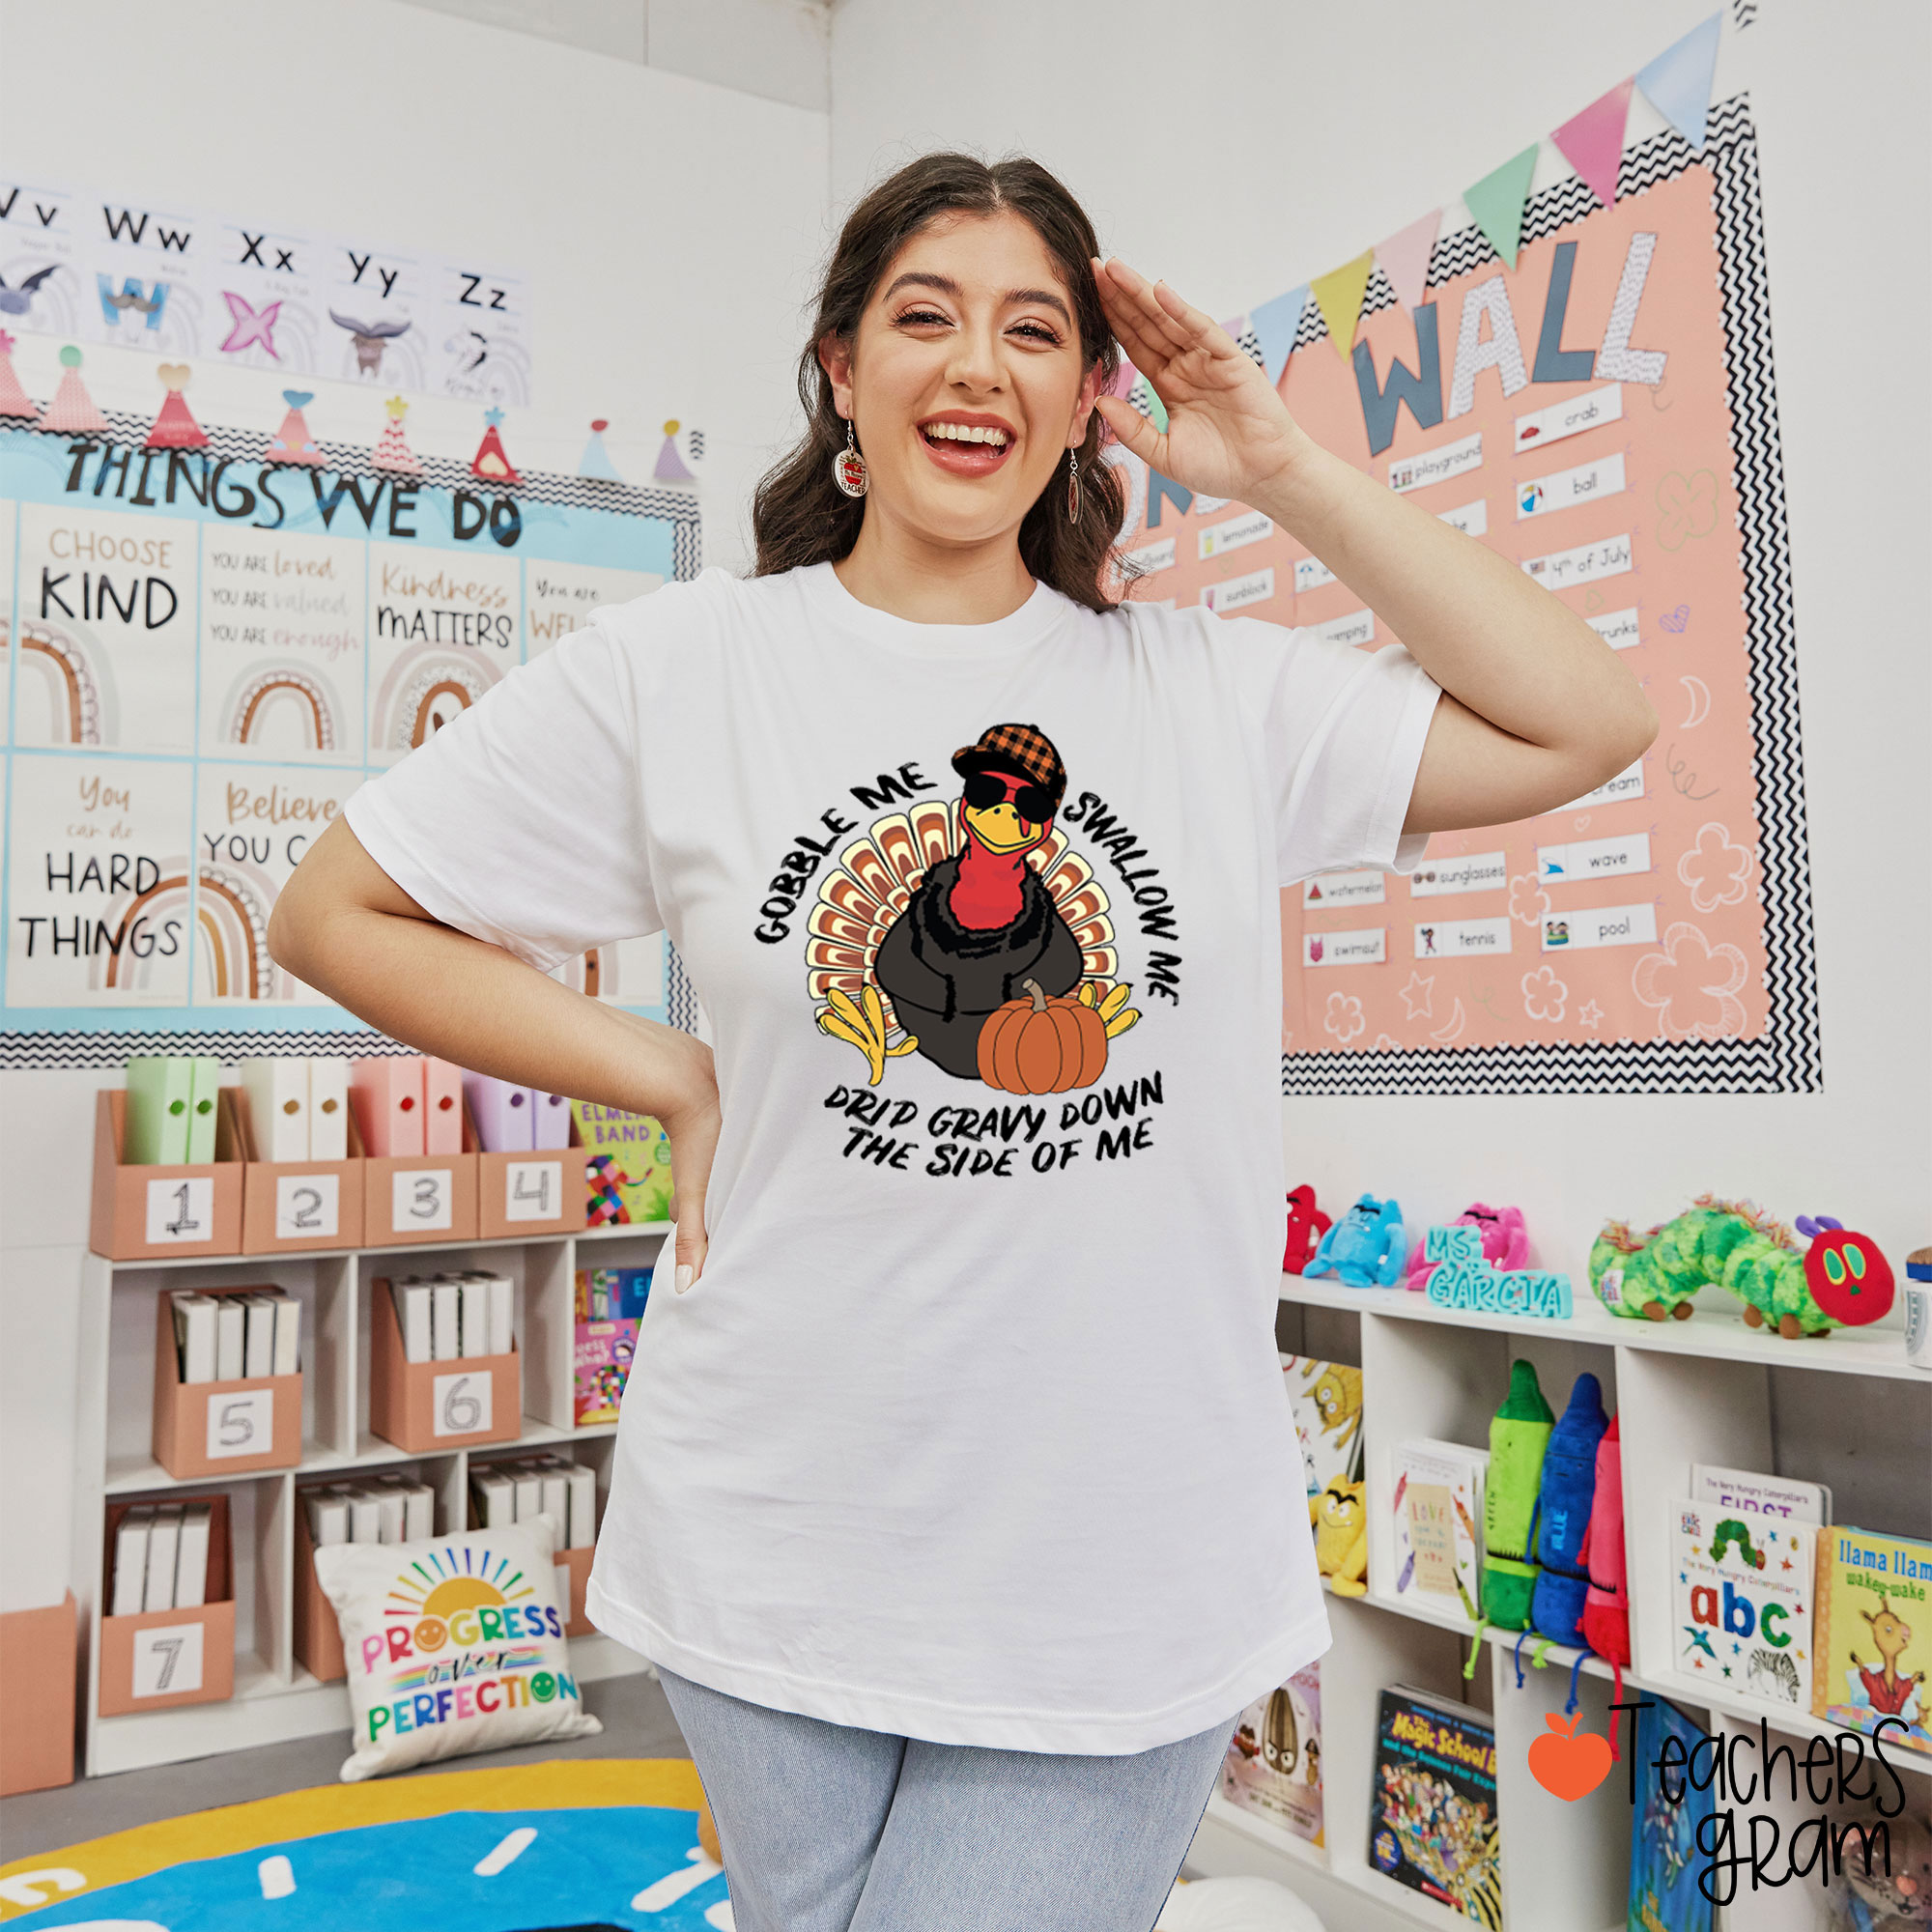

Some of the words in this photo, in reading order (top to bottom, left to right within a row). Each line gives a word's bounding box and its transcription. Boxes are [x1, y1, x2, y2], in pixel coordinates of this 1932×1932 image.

[1351, 232, 1668, 456] WALL
[1565, 402, 1599, 426] crab
[1415, 438, 1482, 480] playground
[65, 443, 284, 529] THINGS
[309, 469, 419, 537] WE
[454, 492, 522, 548] DO
[1574, 471, 1598, 495] ball
[49, 528, 172, 569] CHOOSE
[1222, 520, 1268, 543] lemonade
[211, 553, 239, 570] YOU
[243, 555, 268, 573] ARE
[274, 550, 334, 580] loved
[1577, 553, 1594, 573] of
[1601, 545, 1632, 565] July
[41, 566, 178, 630] KIND
[211, 587, 239, 606] YOU
[242, 591, 268, 609] ARE
[382, 561, 508, 609] Kindness
[536, 579, 567, 598] You
[574, 587, 600, 603] are
[1226, 580, 1267, 603] sunblock
[211, 623, 239, 641] YOU
[242, 626, 266, 644] ARE
[273, 629, 359, 662] enough
[79, 777, 131, 812] You
[226, 781, 338, 825] Believe
[66, 823, 100, 838] can
[109, 821, 133, 840] do
[204, 834, 270, 865] YOU
[753, 808, 859, 944] GOBBLE
[849, 761, 939, 810] ME
[1588, 852, 1628, 868] wave
[46, 851, 160, 895] HARD
[1328, 877, 1383, 897] watermelon
[1439, 863, 1506, 886] sunglasses
[1064, 791, 1180, 941] SWALLOW
[1147, 951, 1183, 1007] ME
[18, 917, 183, 958] THINGS
[1459, 934, 1495, 947] tennis
[1599, 915, 1631, 940] pool
[823, 1084, 919, 1128] DRIP
[926, 1104, 1046, 1144] GRAVY
[1060, 1070, 1165, 1132] DOWN
[595, 1124, 650, 1144] BAND
[841, 1125, 920, 1171] THE
[925, 1143, 1020, 1178] SIDE
[1032, 1139, 1083, 1174] OF
[1094, 1118, 1154, 1160] ME
[165, 1182, 199, 1235] 1
[293, 1187, 323, 1228] 2
[410, 1179, 440, 1218] 3
[513, 1170, 549, 1211] 4
[1429, 1266, 1563, 1319] GARCIA
[218, 1401, 254, 1445] 5
[443, 1378, 481, 1430] 6
[1412, 1500, 1444, 1522] LOVE
[1706, 1478, 1718, 1488] The
[1719, 1480, 1734, 1492] Very
[1737, 1484, 1762, 1496] Hungry
[1764, 1489, 1808, 1504] Caterpillar's
[1550, 1510, 1568, 1550] BLUE
[1683, 1556, 1696, 1568] The
[1698, 1562, 1715, 1576] Very
[1718, 1568, 1746, 1584] Hungry
[1839, 1539, 1888, 1572] llama
[1893, 1550, 1932, 1581] llam
[1846, 1571, 1926, 1602] wakey-wake
[1690, 1580, 1793, 1648] abc
[361, 1605, 562, 1674] PROGRESS
[151, 1637, 185, 1690] 7
[427, 1651, 511, 1685] over
[368, 1670, 580, 1742] PERFECTION
[1392, 1711, 1436, 1749] Magic
[1435, 1727, 1489, 1771] School
